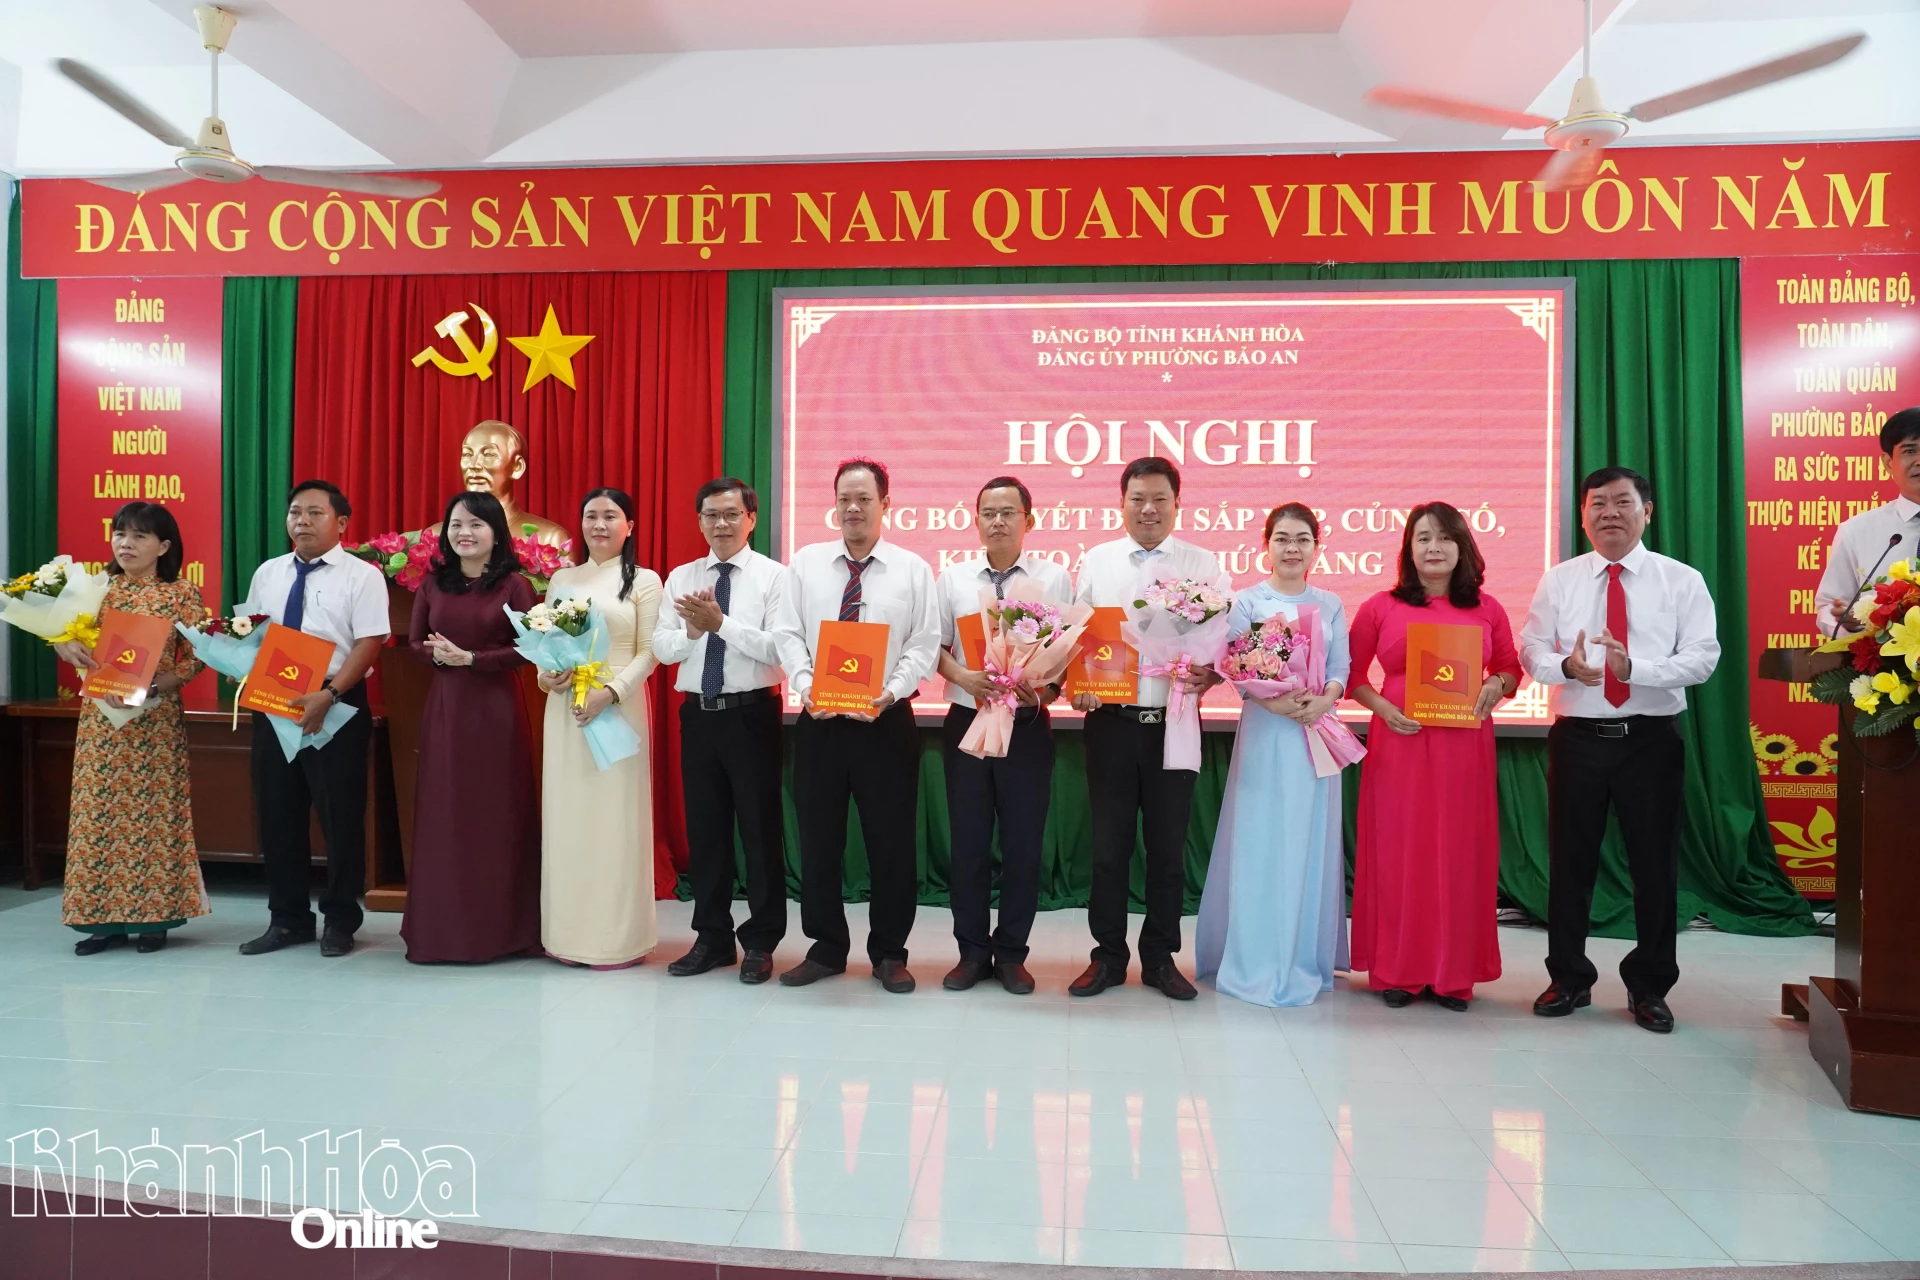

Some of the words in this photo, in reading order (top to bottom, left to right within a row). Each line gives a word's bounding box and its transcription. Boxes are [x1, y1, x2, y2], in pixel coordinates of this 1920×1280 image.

[75, 189, 250, 253] ĐẢNG
[268, 192, 450, 265] CỘNG
[470, 181, 594, 249] SẢN
[613, 184, 771, 260] VIỆT
[791, 190, 951, 243] NAM
[972, 184, 1227, 254] QUANG
[1250, 180, 1438, 237] VINH
[1457, 159, 1690, 235] MUÔN
[1711, 156, 1892, 230] NĂM
[1777, 274, 1825, 305] TOÀN
[1829, 270, 1880, 304] ĐẢNG
[1886, 272, 1915, 308] BỘ,
[115, 290, 165, 323] ĐẢNG
[1032, 326, 1089, 344] ĐẢNG
[1094, 326, 1122, 347] BỘ
[1127, 324, 1176, 343] TỈNH
[1181, 324, 1254, 343] KHÁNH
[1261, 323, 1304, 342] HÒA
[1797, 318, 1845, 348] TOÀN
[1851, 317, 1894, 350] DÂN,
[96, 337, 143, 372] CỘNG
[149, 334, 185, 366] SẢN
[1037, 347, 1095, 366] ĐẢNG
[1101, 347, 1128, 366] ỦY
[1132, 346, 1218, 365] PHƯỜNG
[1224, 346, 1266, 365] BẢO
[1270, 350, 1299, 364] AN
[1794, 363, 1841, 392] TOÀN
[1847, 362, 1897, 395] QUÂN
[98, 382, 135, 416] VIỆT
[140, 387, 181, 411] NAM
[1771, 406, 1845, 437] PHƯỜNG
[112, 425, 167, 455] NGƯỜI
[1003, 413, 1127, 478] HỘI
[1144, 420, 1318, 478] NGHỊ
[1774, 457, 1798, 481] RA
[1803, 451, 1840, 482] SỨC
[1845, 457, 1873, 481] THI
[94, 470, 140, 498] LÃNH
[145, 475, 185, 504] ĐẠO,
[926, 501, 971, 531] BỐ
[1194, 501, 1255, 532] SẮP
[1341, 501, 1411, 532] CỦN
[1459, 502, 1506, 538] Ố,
[1748, 499, 1793, 532] THỰC
[1799, 496, 1841, 531] HIỆN
[1310, 544, 1384, 576] ẢNG
[1798, 537, 1820, 570] KẾ
